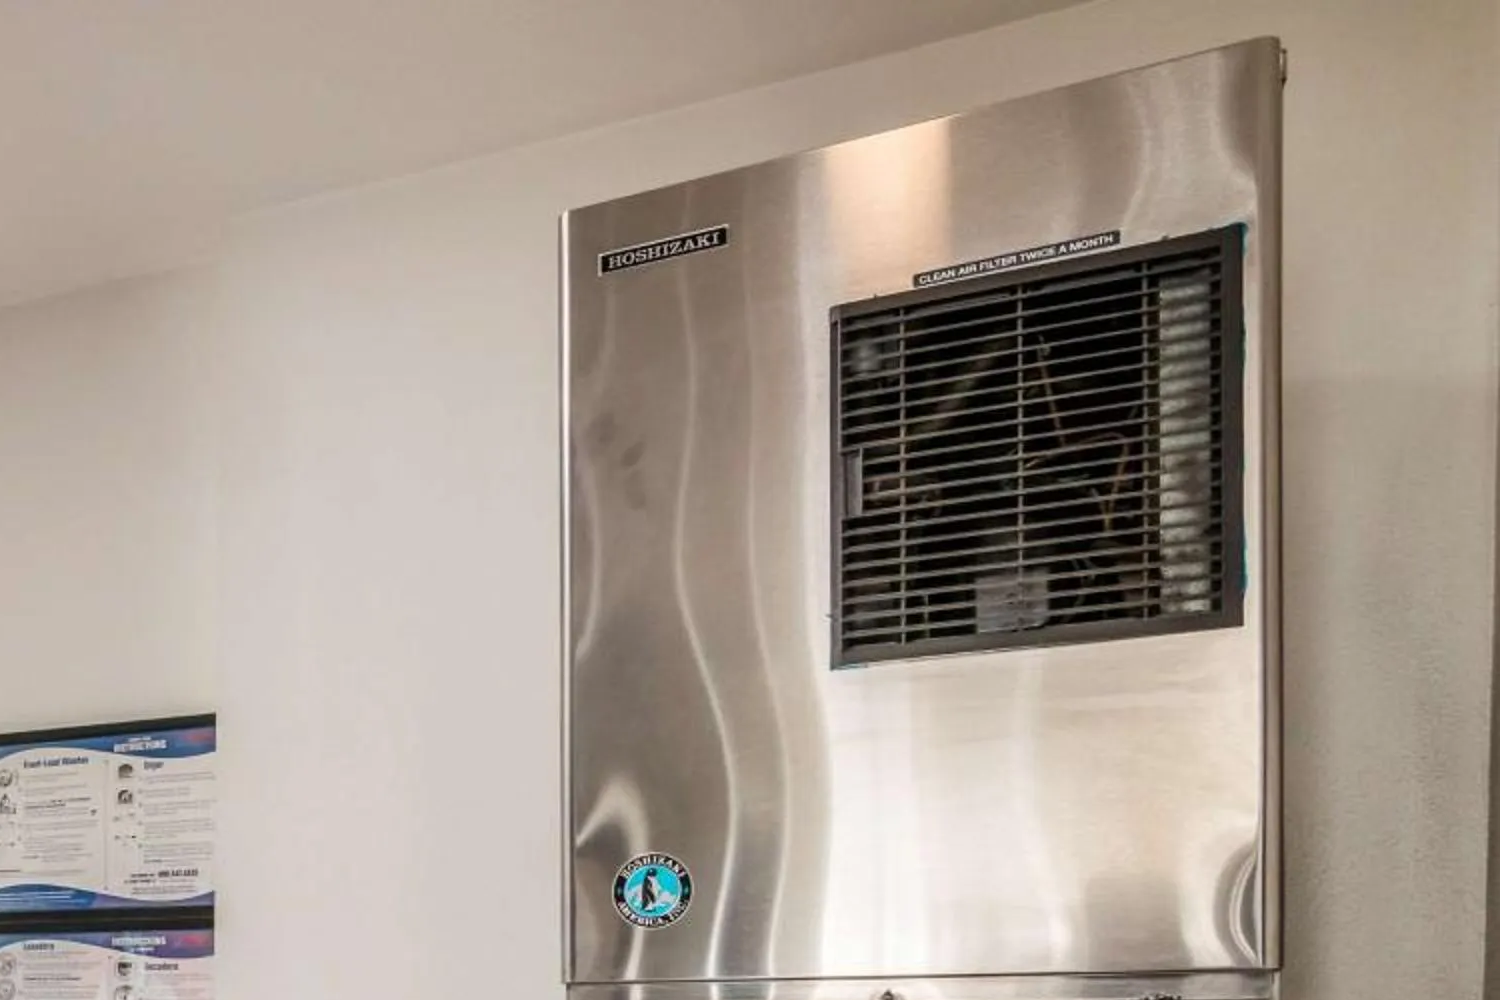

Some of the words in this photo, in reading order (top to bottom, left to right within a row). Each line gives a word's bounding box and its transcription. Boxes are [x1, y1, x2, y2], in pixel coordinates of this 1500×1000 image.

[608, 231, 721, 269] HOSHIZAKI
[918, 269, 957, 285] CLEAN
[958, 262, 978, 278] AIR
[979, 255, 1017, 272] FILTER
[1020, 247, 1057, 263] TWICE
[1059, 244, 1068, 255] A
[1069, 234, 1114, 252] MONTH
